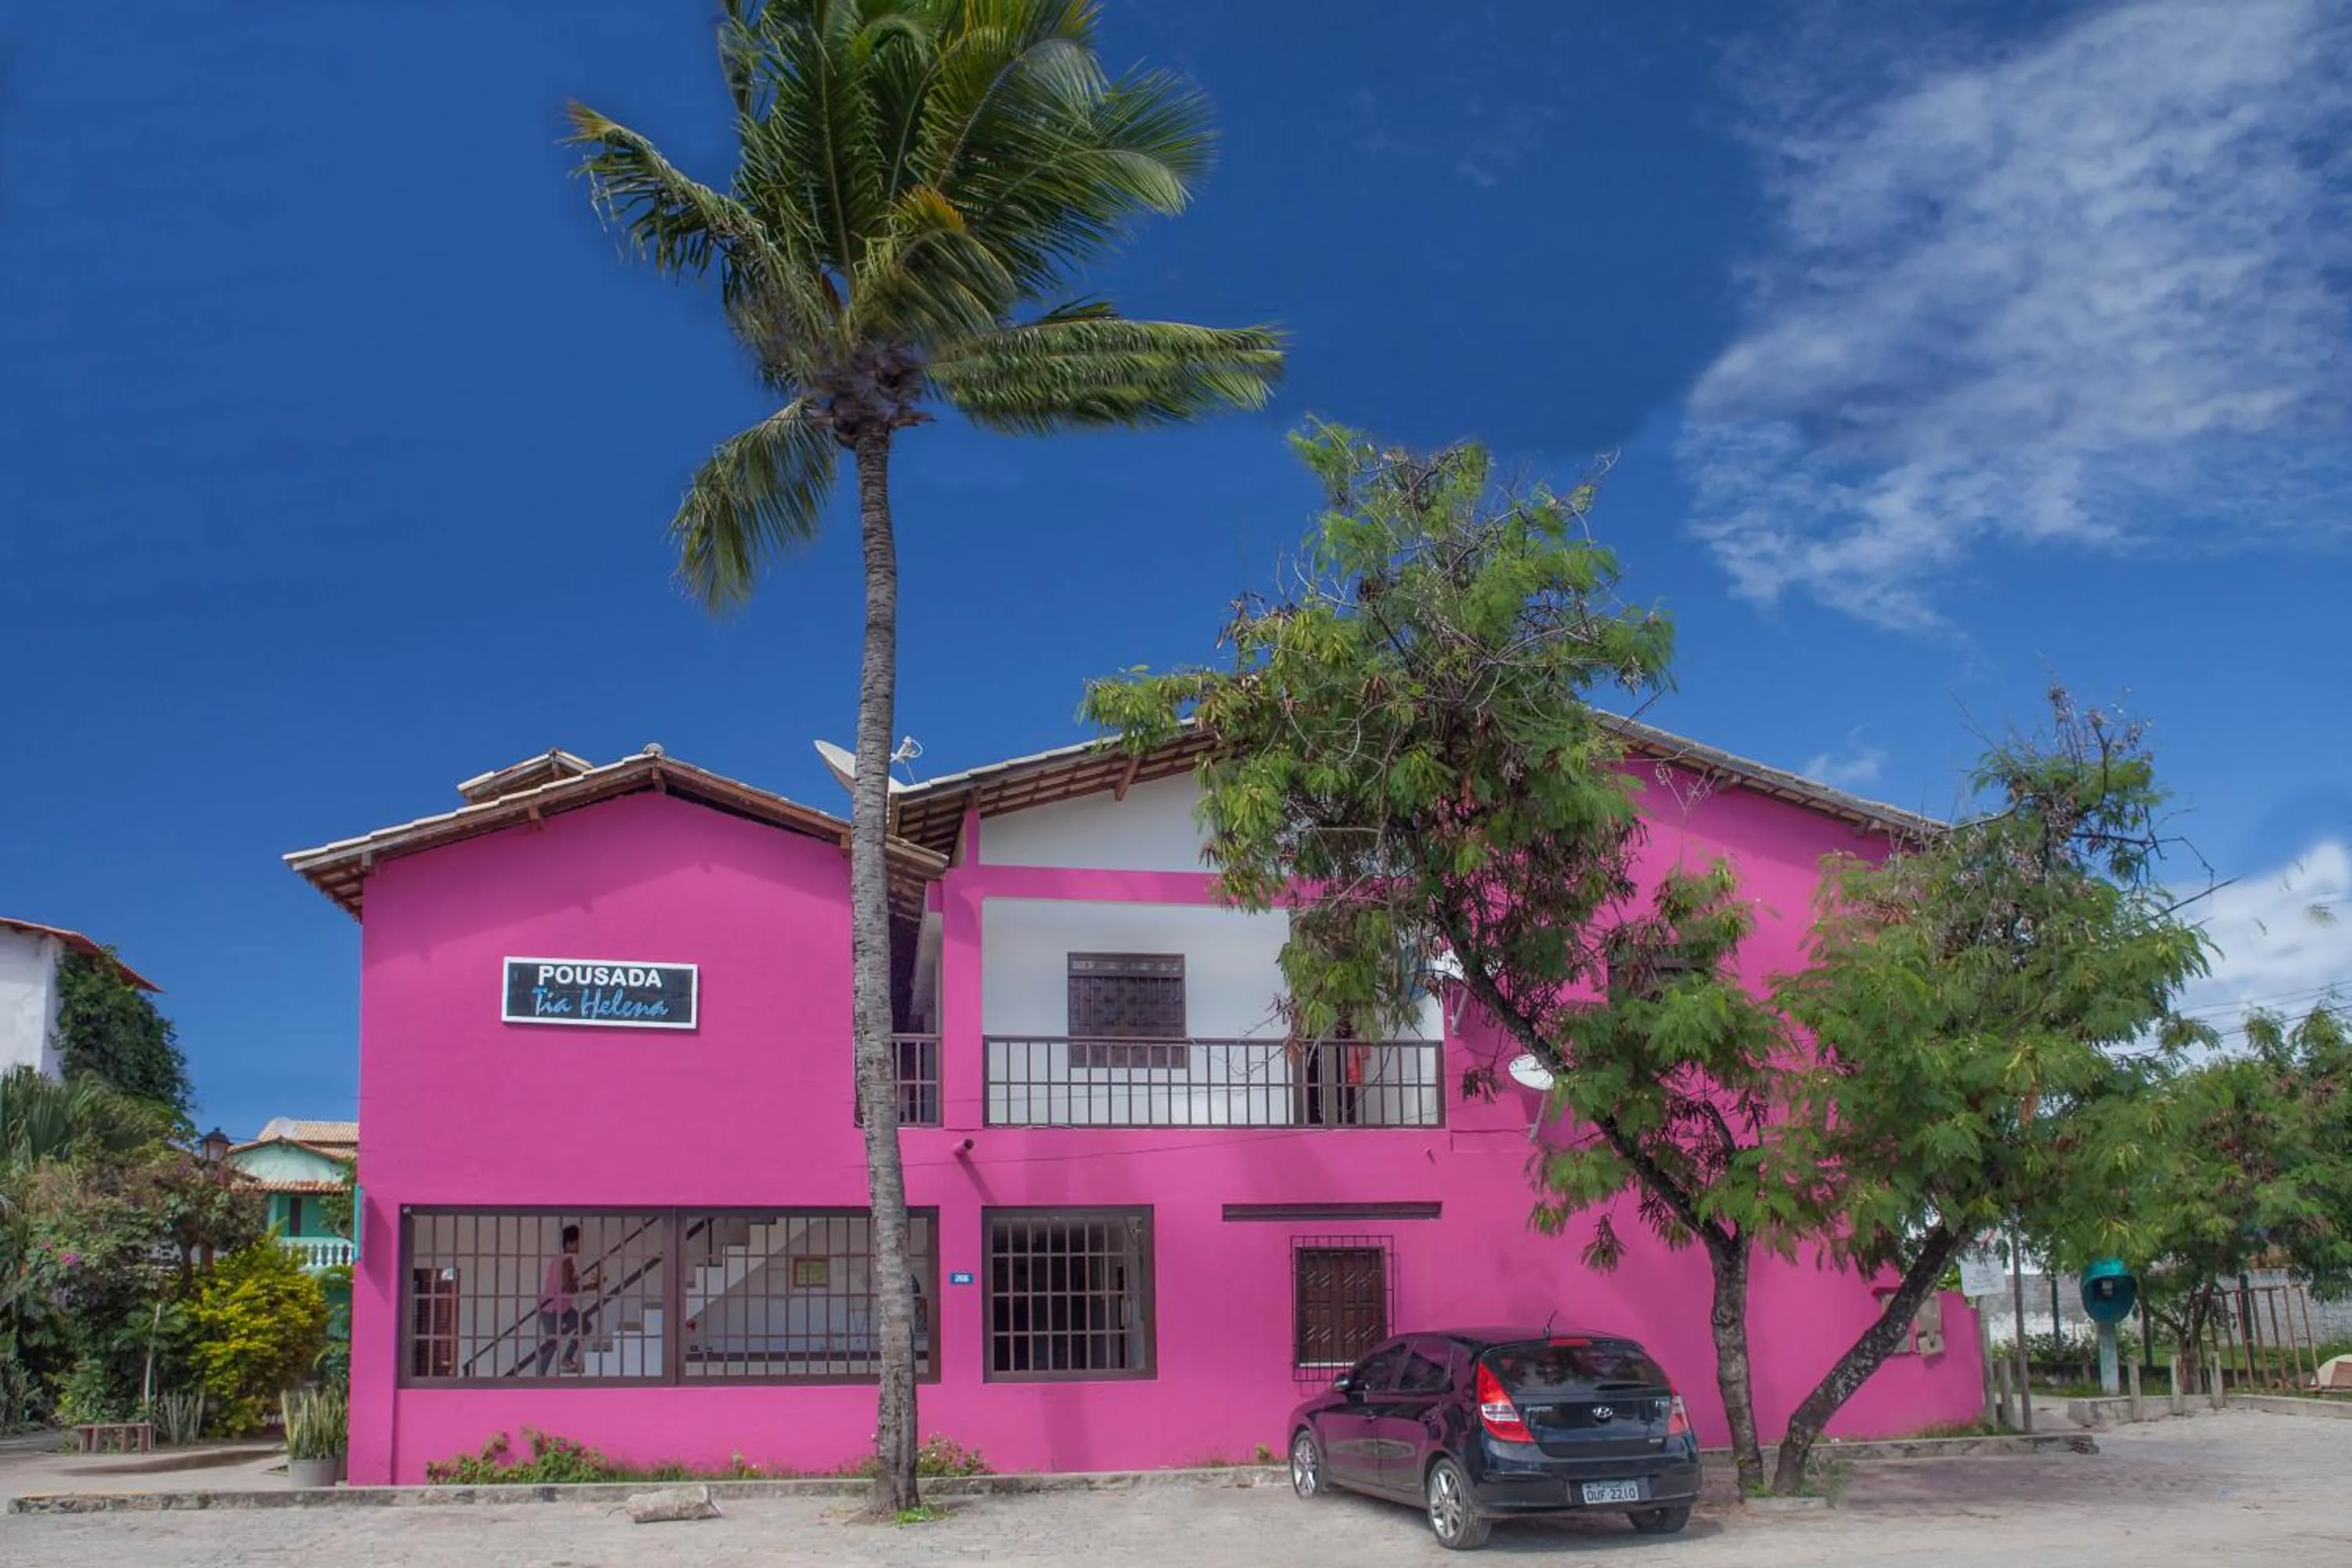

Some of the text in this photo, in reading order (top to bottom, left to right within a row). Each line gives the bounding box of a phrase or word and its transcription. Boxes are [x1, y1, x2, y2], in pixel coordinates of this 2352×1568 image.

[538, 965, 662, 987] POUSADA
[532, 985, 669, 1019] Tia Helena
